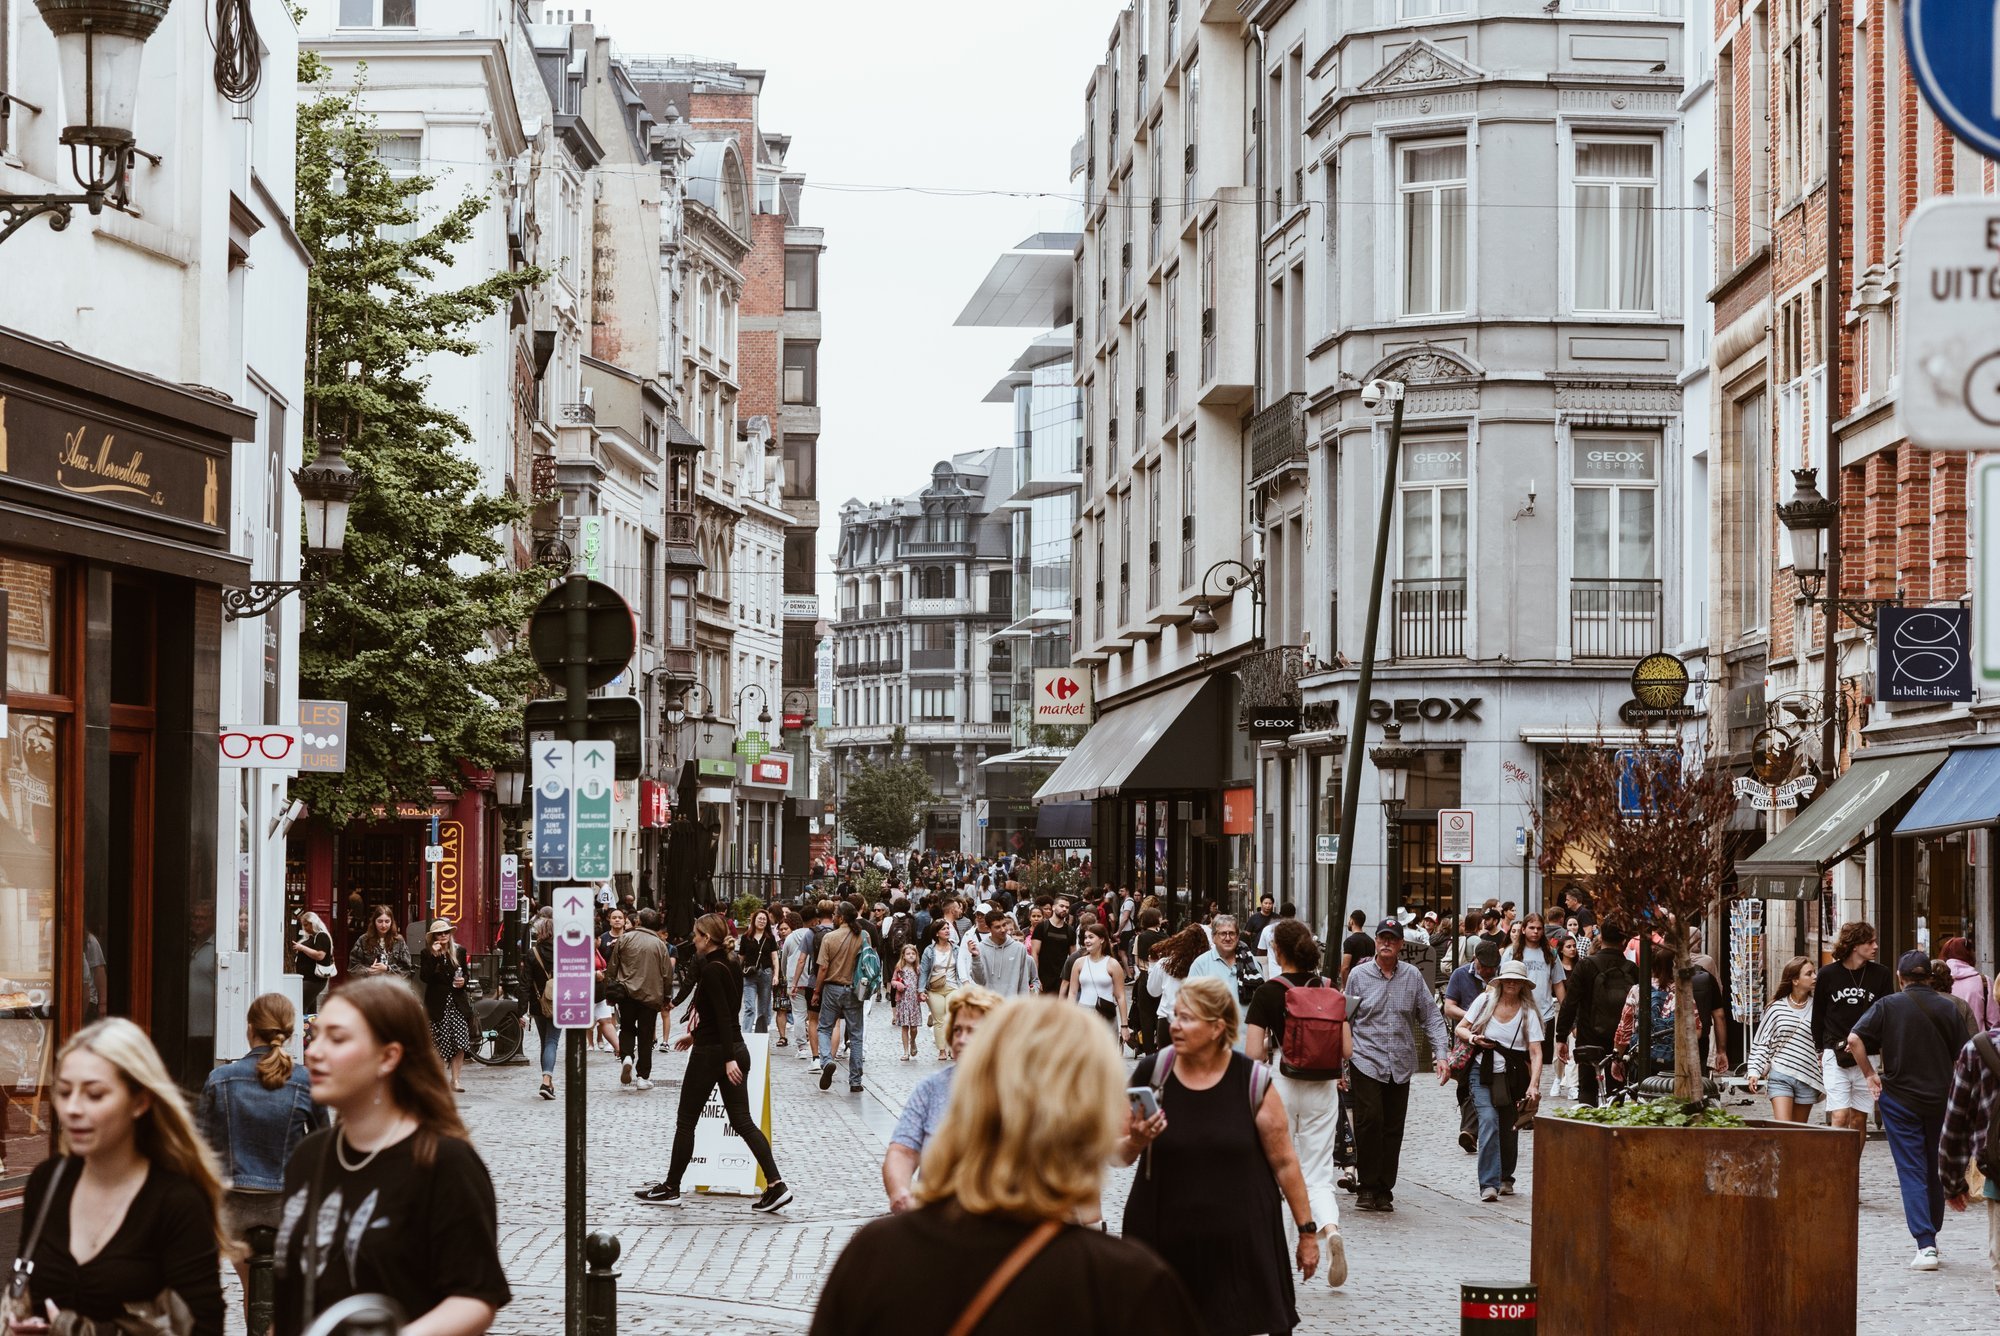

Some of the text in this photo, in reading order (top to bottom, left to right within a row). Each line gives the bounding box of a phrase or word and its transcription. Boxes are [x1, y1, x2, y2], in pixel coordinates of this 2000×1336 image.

[59, 426, 151, 488] Aux Merveilleux
[1413, 451, 1462, 463] GEOX
[1587, 450, 1644, 462] GEOX
[1587, 461, 1645, 470] RESPIRA
[1893, 685, 1902, 696] la
[1039, 702, 1086, 716] market
[1368, 697, 1484, 722] GEOX
[1254, 719, 1295, 728] GEOX
[1049, 839, 1087, 848] LE CONTEUR
[441, 827, 458, 917] NICOLAS
[1489, 1304, 1526, 1319] STOP
